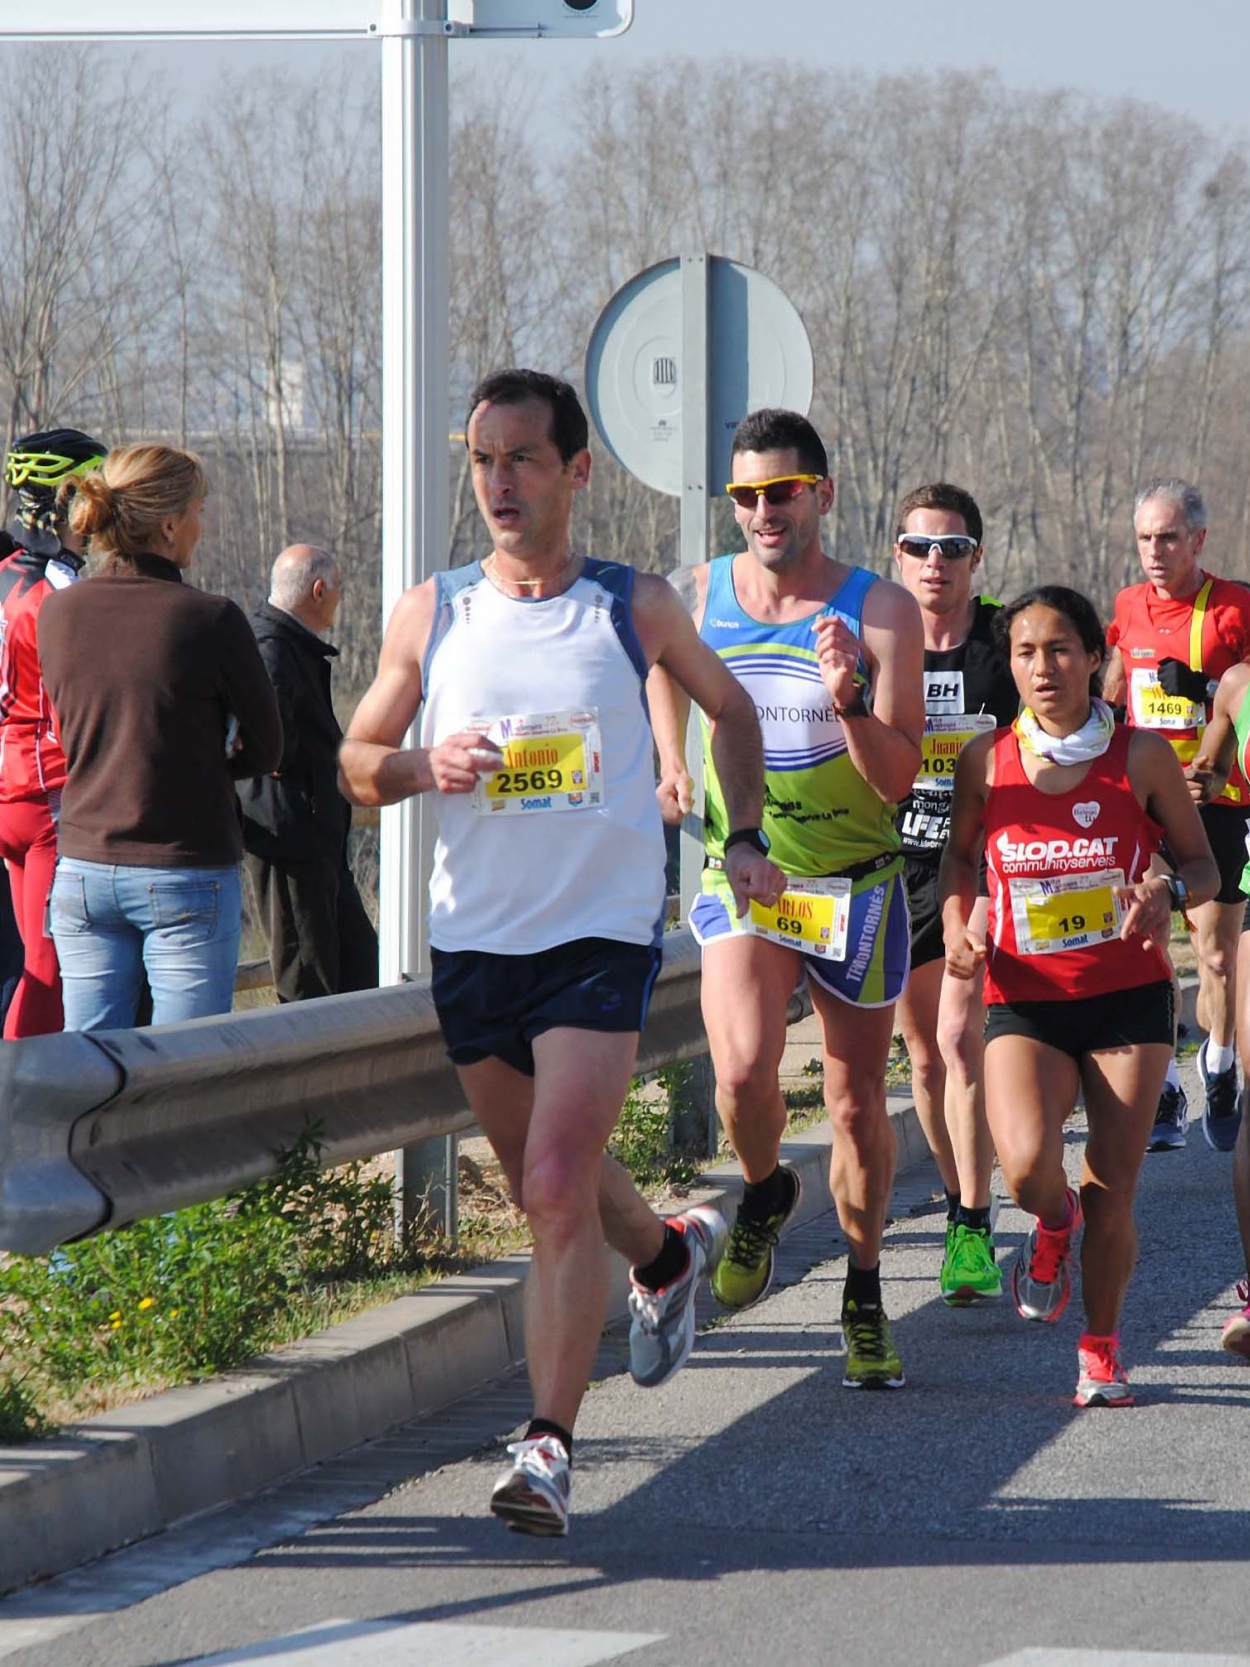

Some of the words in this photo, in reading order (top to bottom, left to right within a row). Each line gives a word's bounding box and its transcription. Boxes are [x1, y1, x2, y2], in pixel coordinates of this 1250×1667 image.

[926, 683, 959, 698] BH
[756, 704, 840, 723] ONTORNÈ
[1148, 702, 1182, 715] 1469
[506, 742, 558, 769] Antonio
[922, 758, 956, 774] 103
[496, 770, 563, 794] 2569
[521, 796, 552, 810] Somat
[902, 811, 944, 840] LIFE
[1002, 856, 1116, 874] communityservers
[776, 898, 813, 920] ARLOS
[777, 916, 802, 934] 69
[1058, 915, 1086, 932] 19
[1062, 934, 1088, 948] Somat
